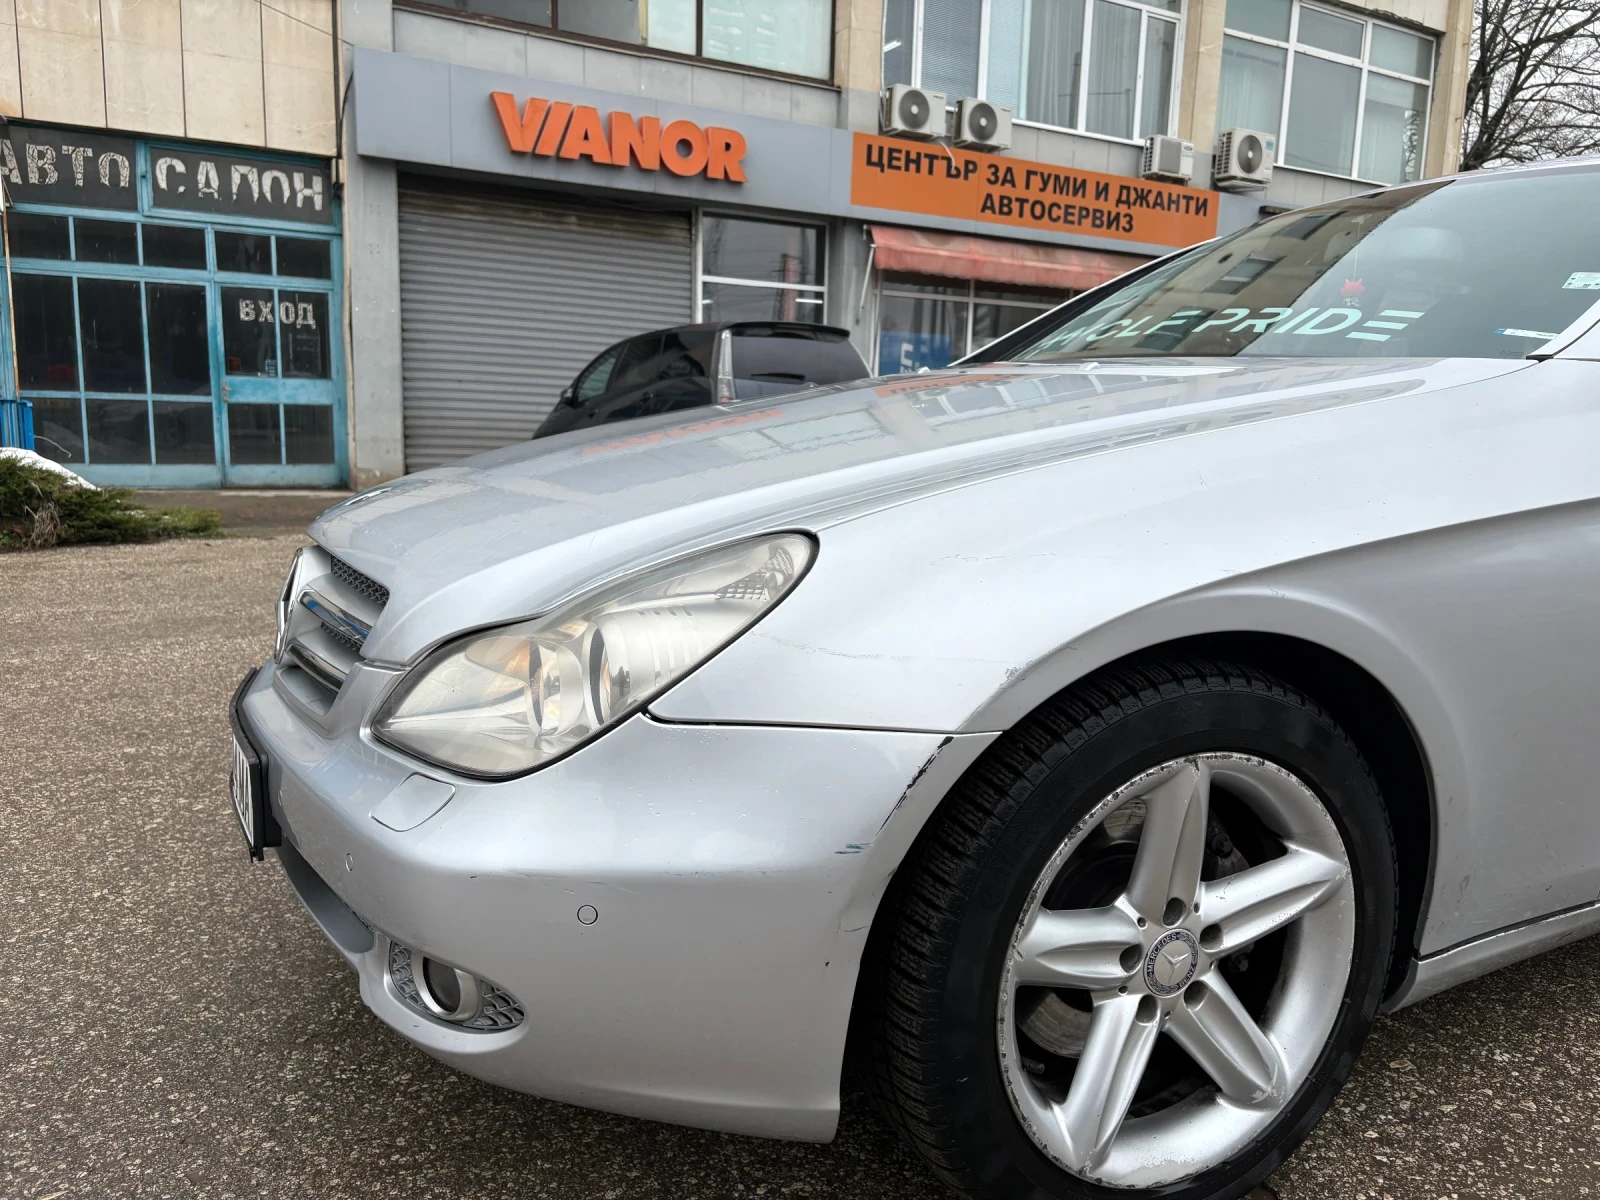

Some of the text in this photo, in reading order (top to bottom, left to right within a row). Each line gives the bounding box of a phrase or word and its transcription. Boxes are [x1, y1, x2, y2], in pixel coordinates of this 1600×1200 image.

[490, 91, 748, 183] VIANOR
[865, 144, 1209, 217] ЦЕНТЪР ЗА ГУМИ И ДЖАНТИ
[980, 193, 1134, 233] АВТОСЕРВИЗ
[239, 299, 316, 329] ВХОД
[1147, 932, 1177, 973] MERCEDES
[1179, 966, 1196, 988] BENZ
